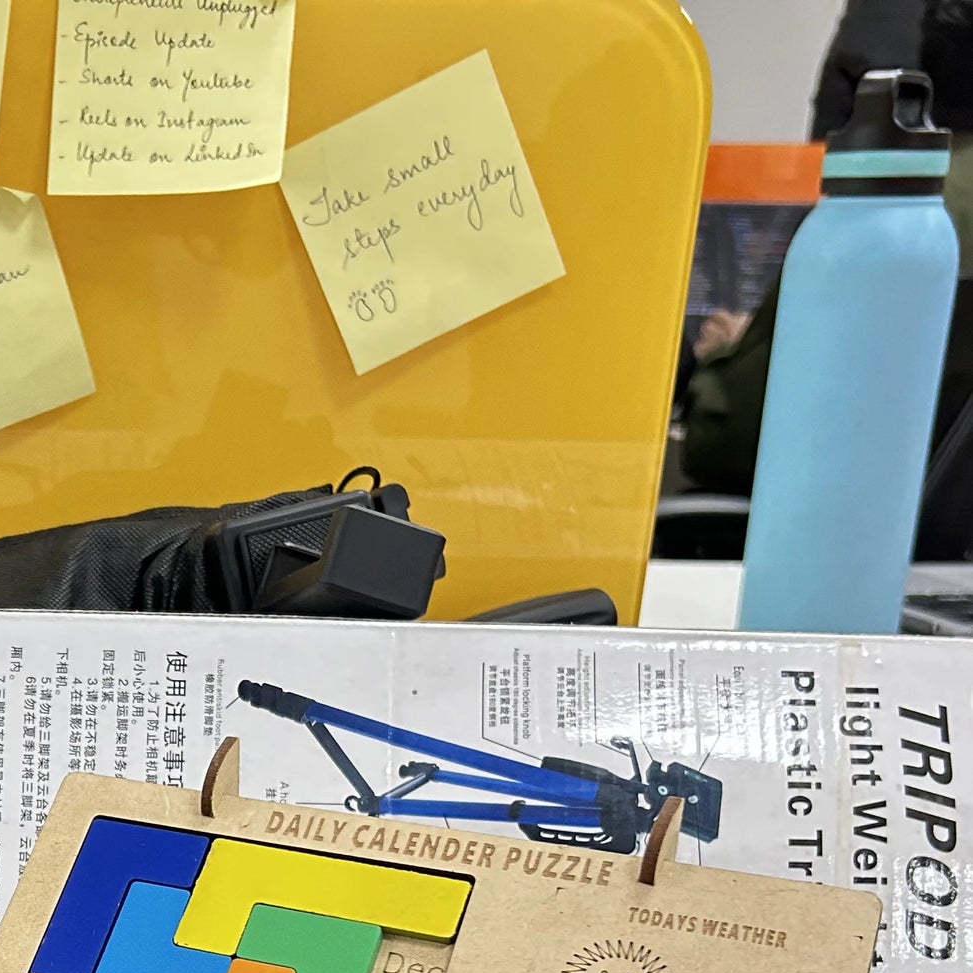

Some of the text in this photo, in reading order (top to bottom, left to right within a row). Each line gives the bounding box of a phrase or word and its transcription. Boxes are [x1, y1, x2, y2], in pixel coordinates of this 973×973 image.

[74, 21, 215, 67] Episode Update
[78, 68, 133, 87] Shorts
[149, 76, 172, 90] on
[80, 105, 251, 143] Reels on Instagram
[76, 141, 135, 177] Update
[149, 152, 172, 163] on
[301, 134, 457, 227] Take small
[342, 217, 402, 271] steps
[55, 648, 69, 696] 下相机。
[101, 650, 115, 710] 固定锁紧。
[131, 649, 147, 725] 后小心使用。
[217, 658, 225, 686] Rubber
[520, 653, 531, 740] Platform locking knob
[215, 687, 224, 718] antiskid
[215, 719, 223, 737] foot
[781, 670, 823, 817] Plastic
[839, 687, 884, 787] light
[265, 810, 614, 887] DAILY CALENDER PUZZLE
[898, 704, 959, 960] TRIPOD
[629, 906, 787, 949] TODAYS WEATHER
